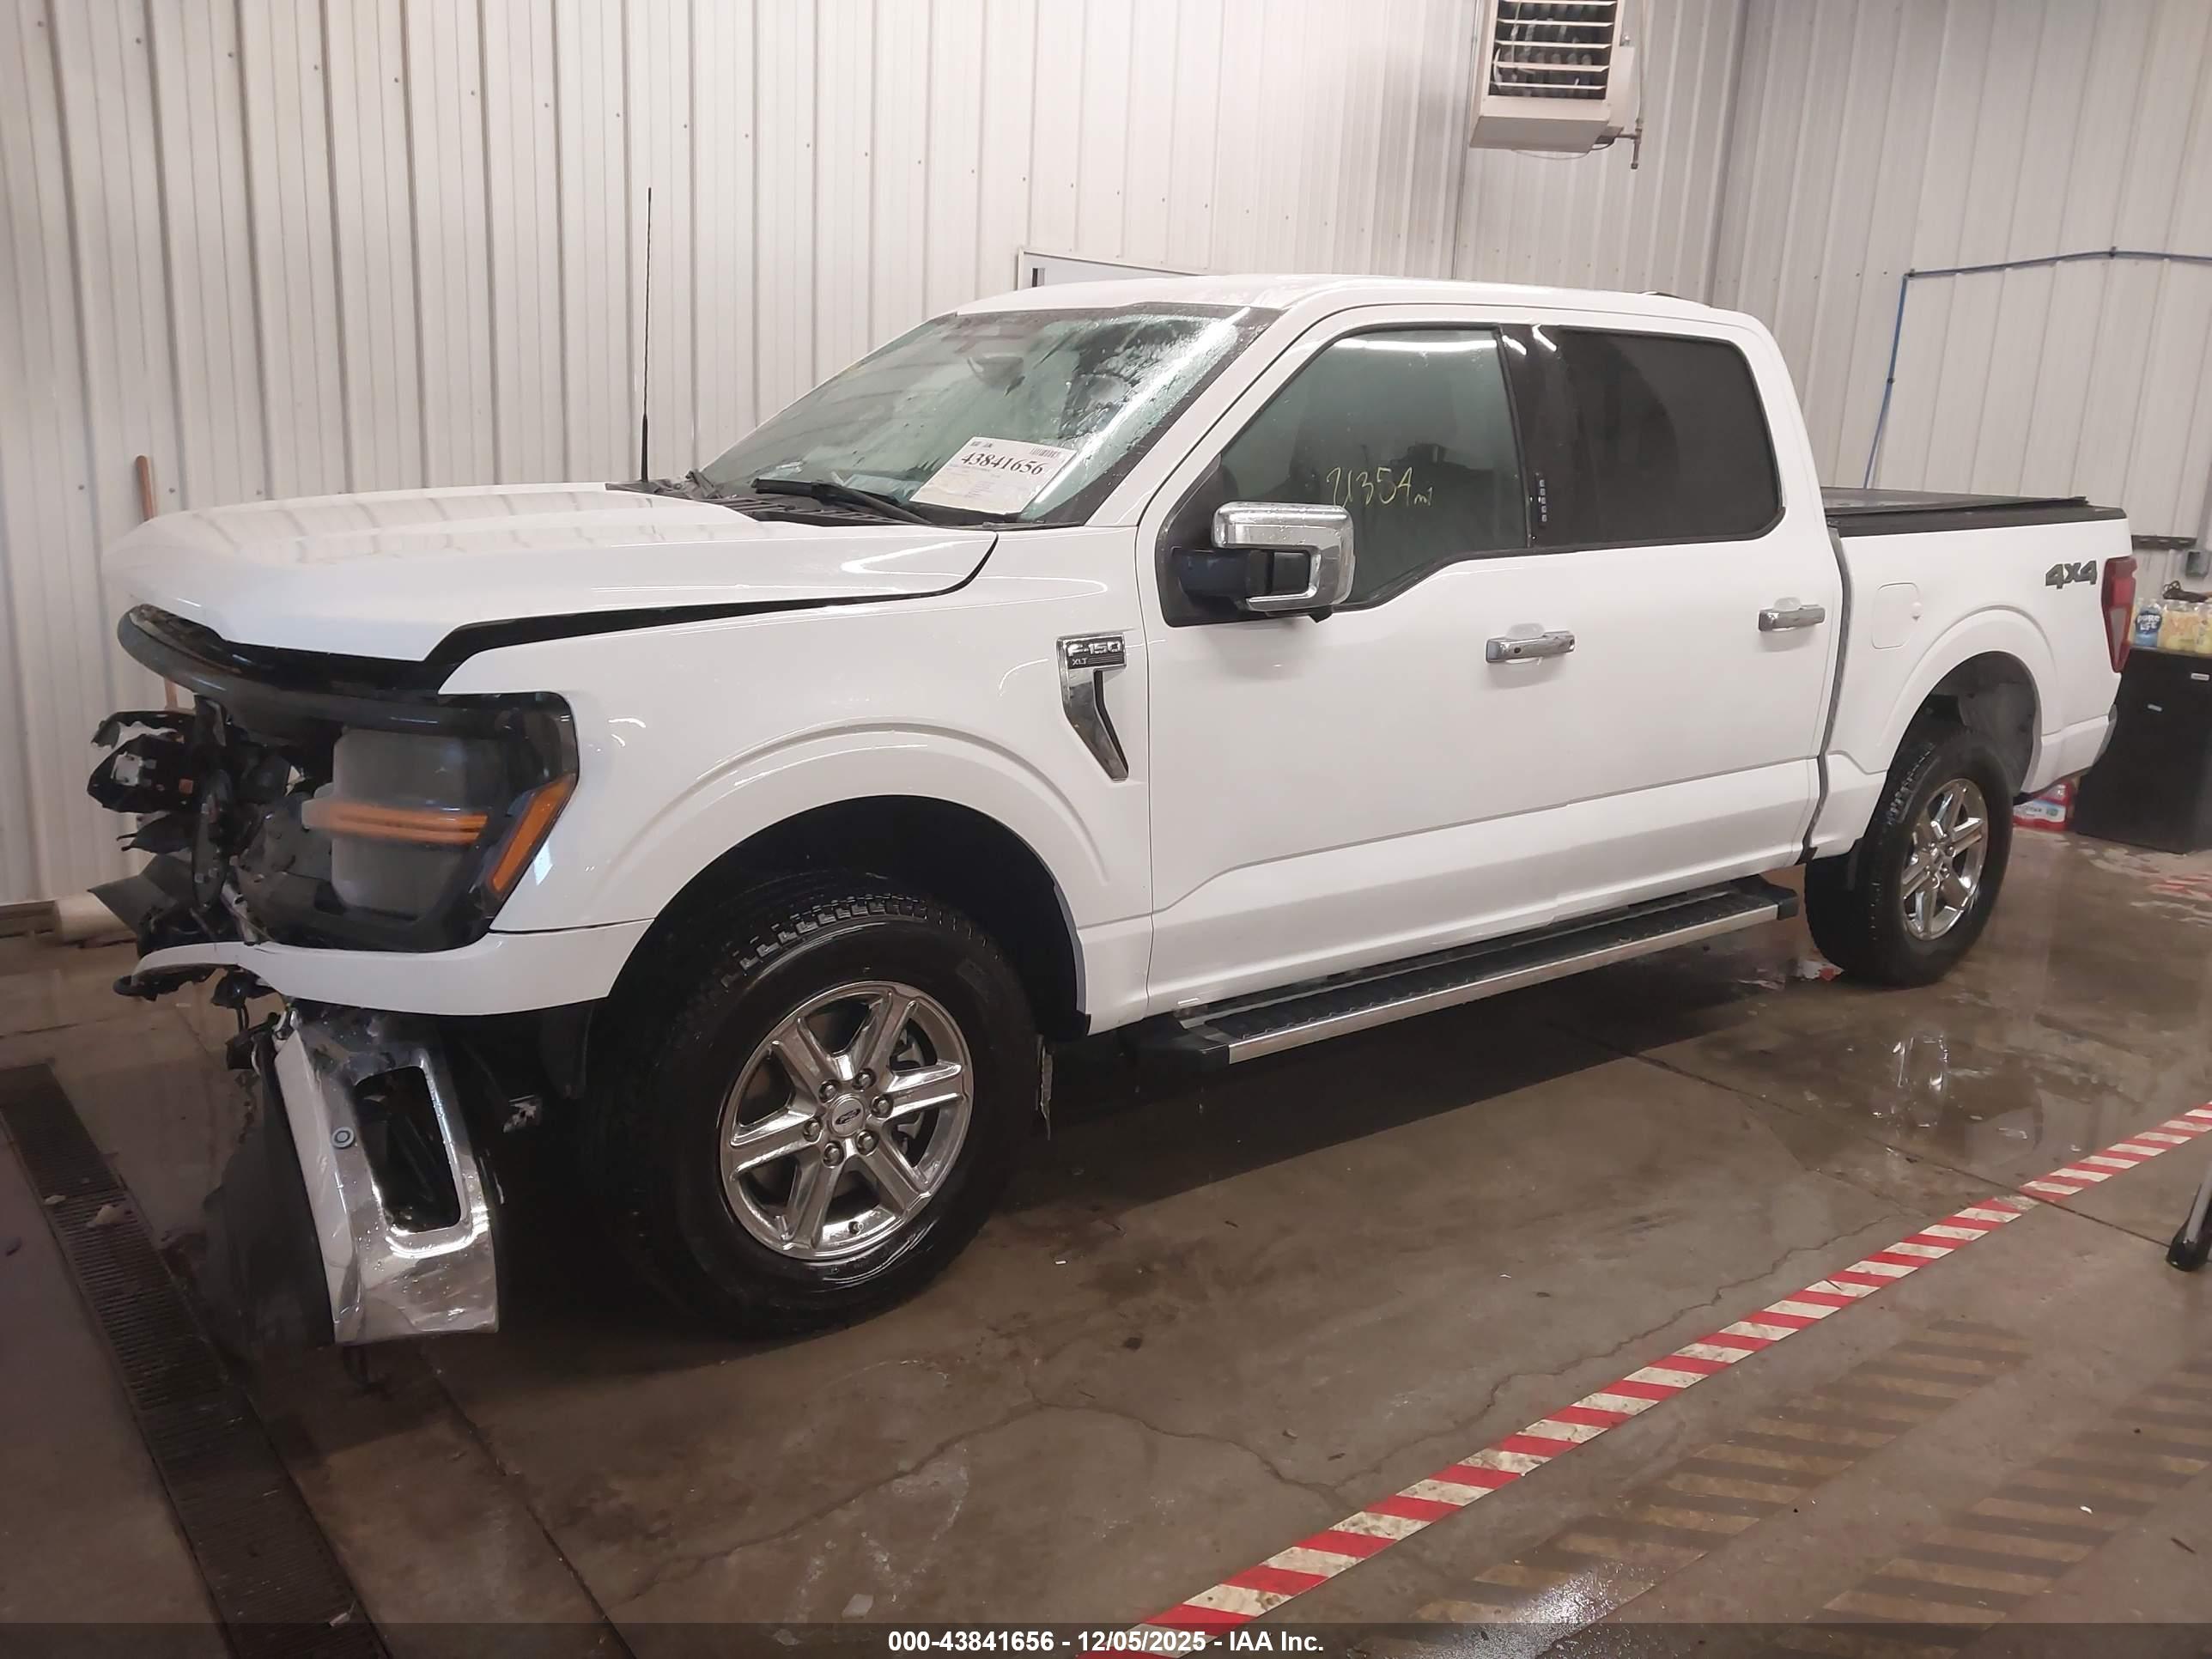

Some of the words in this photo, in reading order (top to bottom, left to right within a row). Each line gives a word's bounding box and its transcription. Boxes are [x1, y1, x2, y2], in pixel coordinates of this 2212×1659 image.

[961, 452, 1048, 475] 43841656
[1067, 641, 1121, 657] F-150
[1073, 658, 1088, 666] XLT
